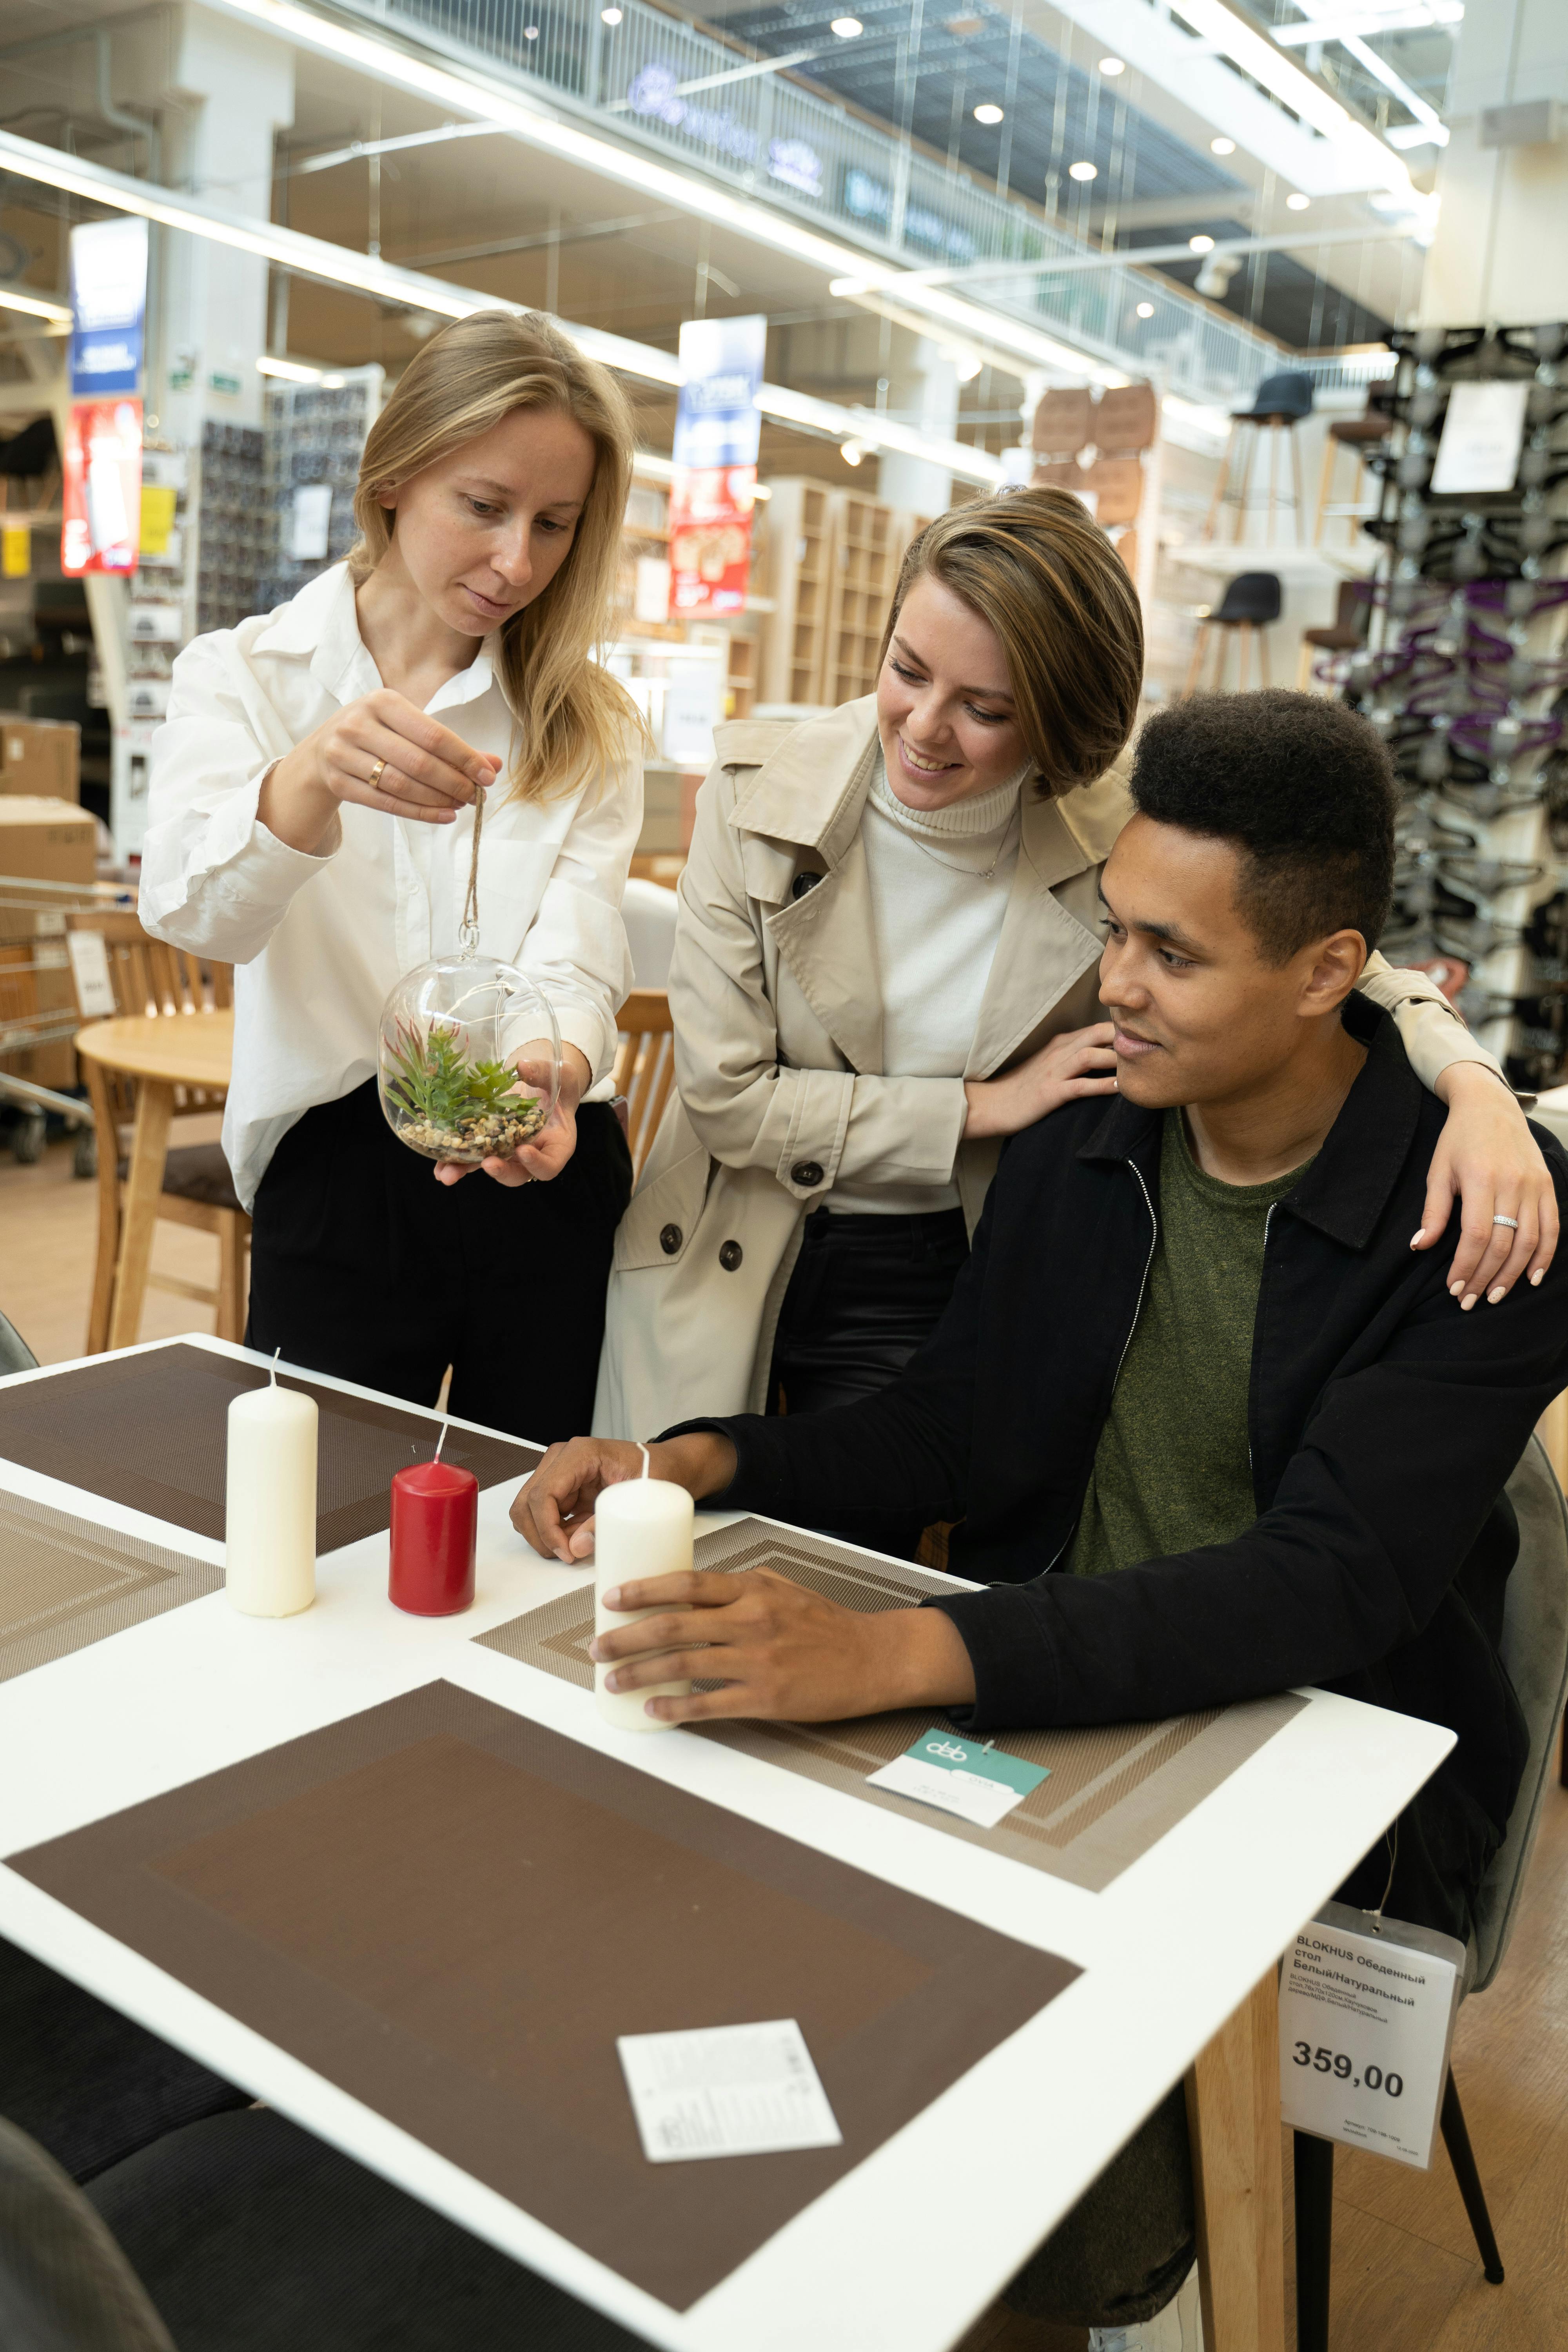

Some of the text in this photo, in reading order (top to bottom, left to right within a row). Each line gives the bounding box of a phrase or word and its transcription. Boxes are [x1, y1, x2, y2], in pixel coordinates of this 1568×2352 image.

[1295, 1949, 1321, 1962] стол
[1297, 1935, 1425, 1984] BLOKHUS Обеденный
[1290, 1973, 1356, 1998] BLOKHUS Обеденный
[1294, 1959, 1414, 2006] Белый/Натуральный
[1292, 2041, 1403, 2097] 359,00
